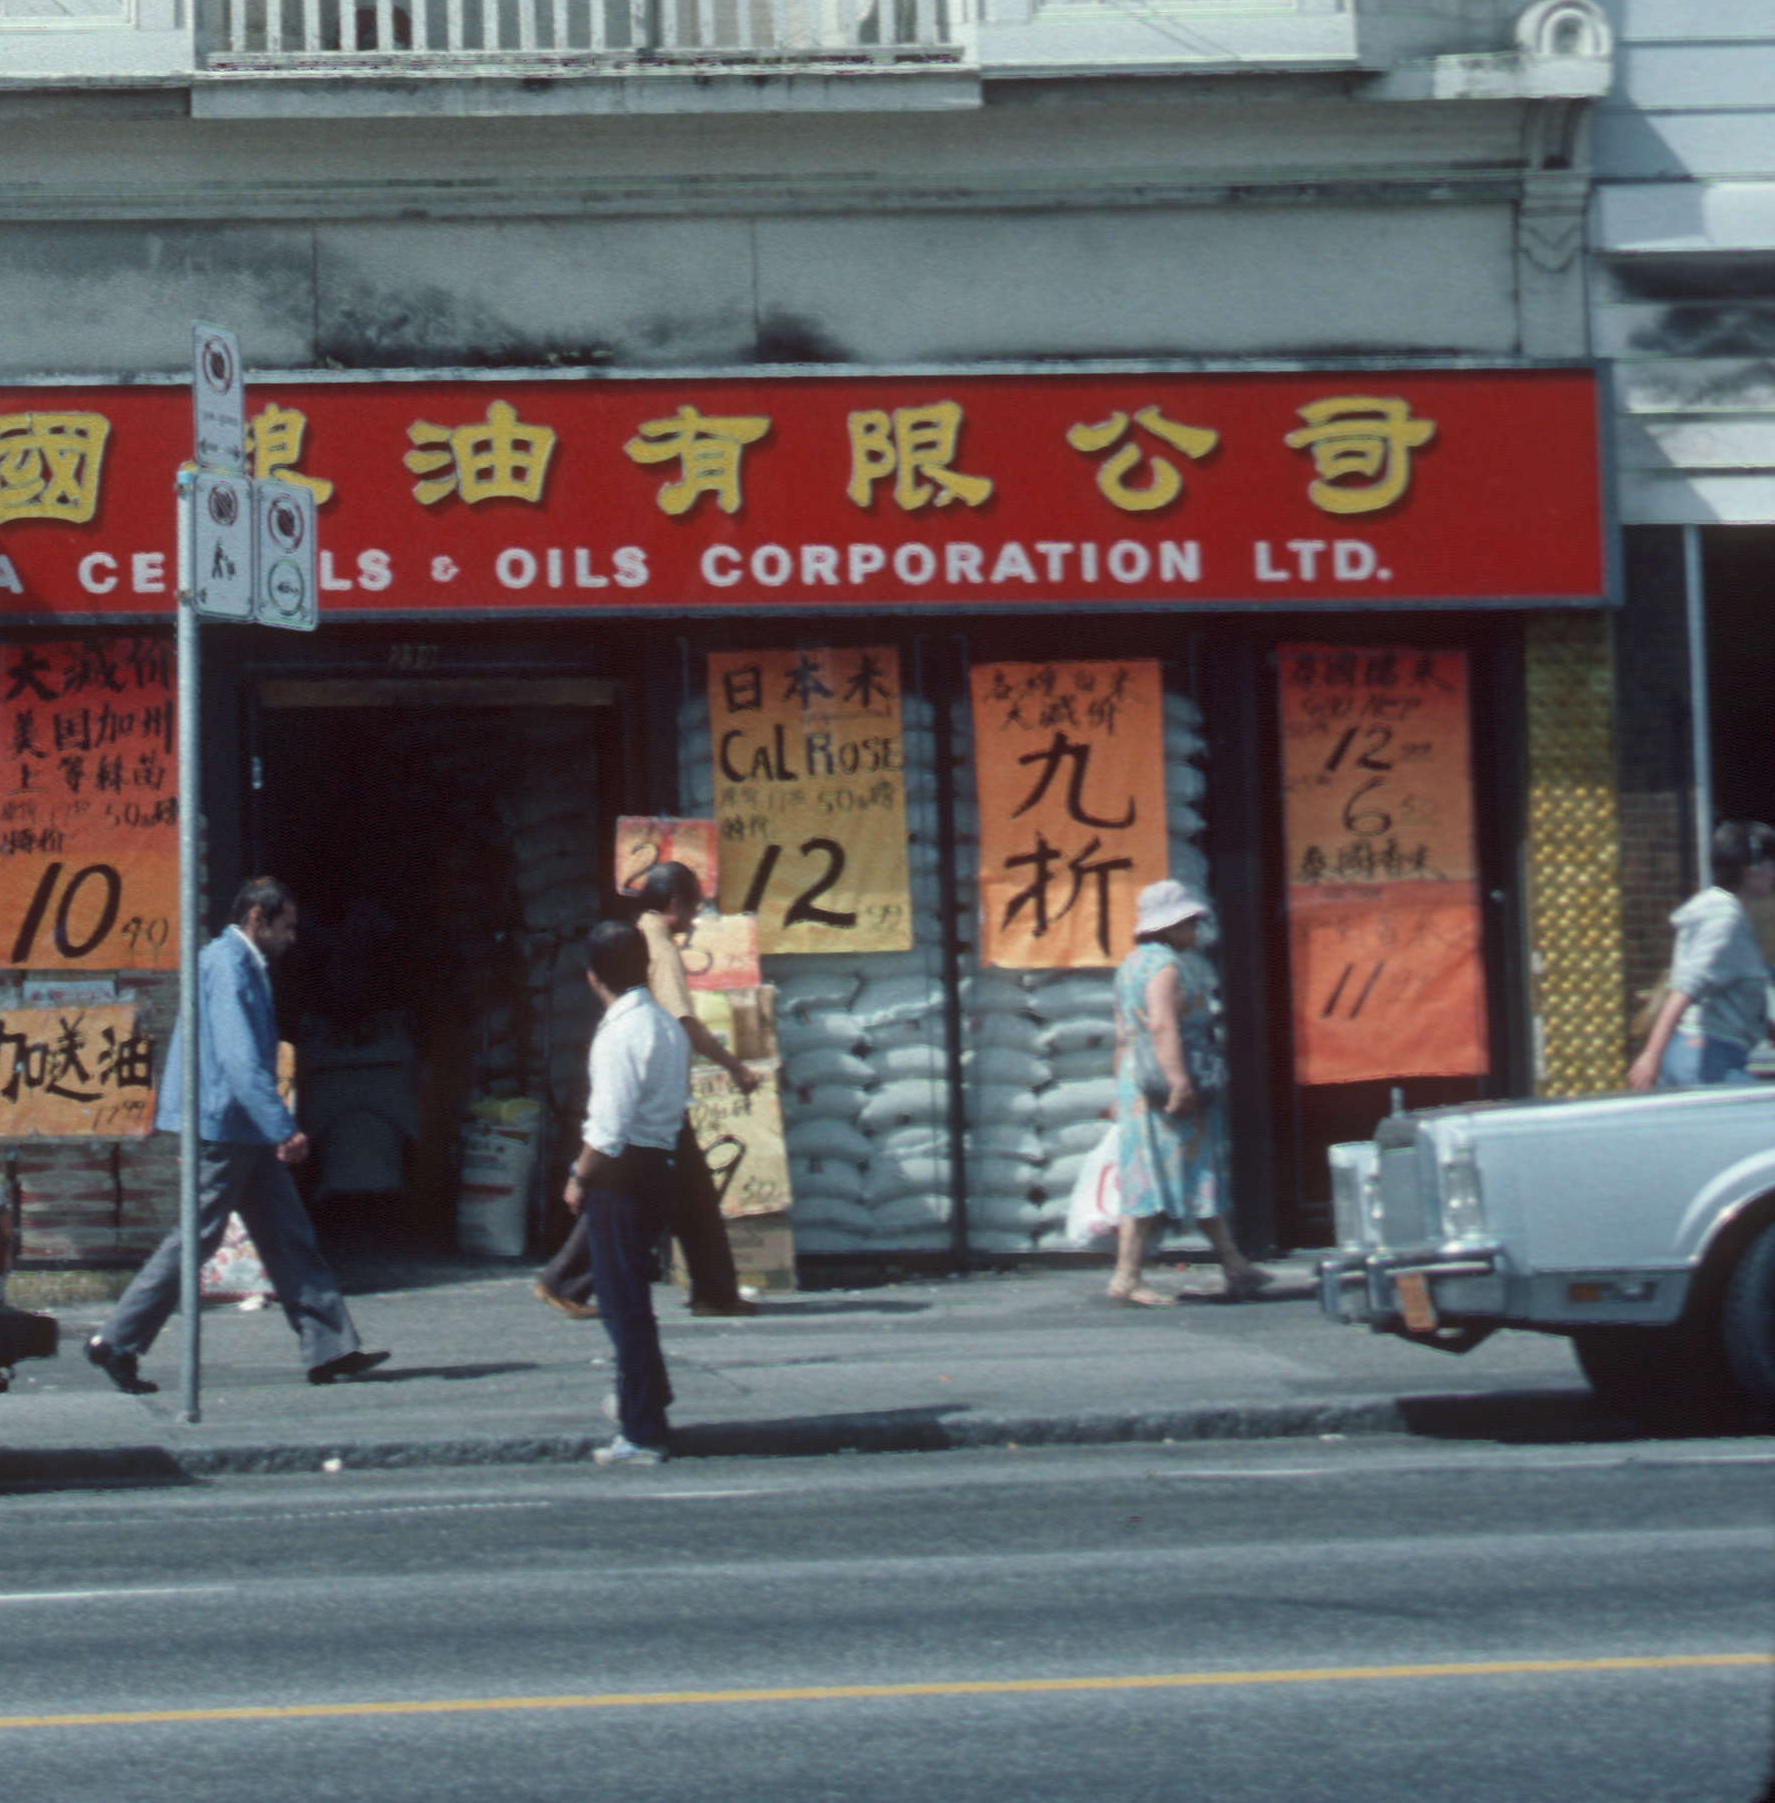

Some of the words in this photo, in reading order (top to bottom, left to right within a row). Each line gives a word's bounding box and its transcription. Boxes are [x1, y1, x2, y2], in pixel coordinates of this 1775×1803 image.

[77, 548, 393, 594] CELS
[430, 555, 460, 583] &
[494, 545, 650, 590] OILS
[699, 539, 1202, 588] CORPORATION
[1254, 538, 1394, 582] LTD.
[1324, 725, 1393, 773] 12
[1000, 730, 1137, 958] 九折
[1343, 776, 1392, 838] 6
[11, 861, 122, 964] 10
[744, 837, 857, 930] 12
